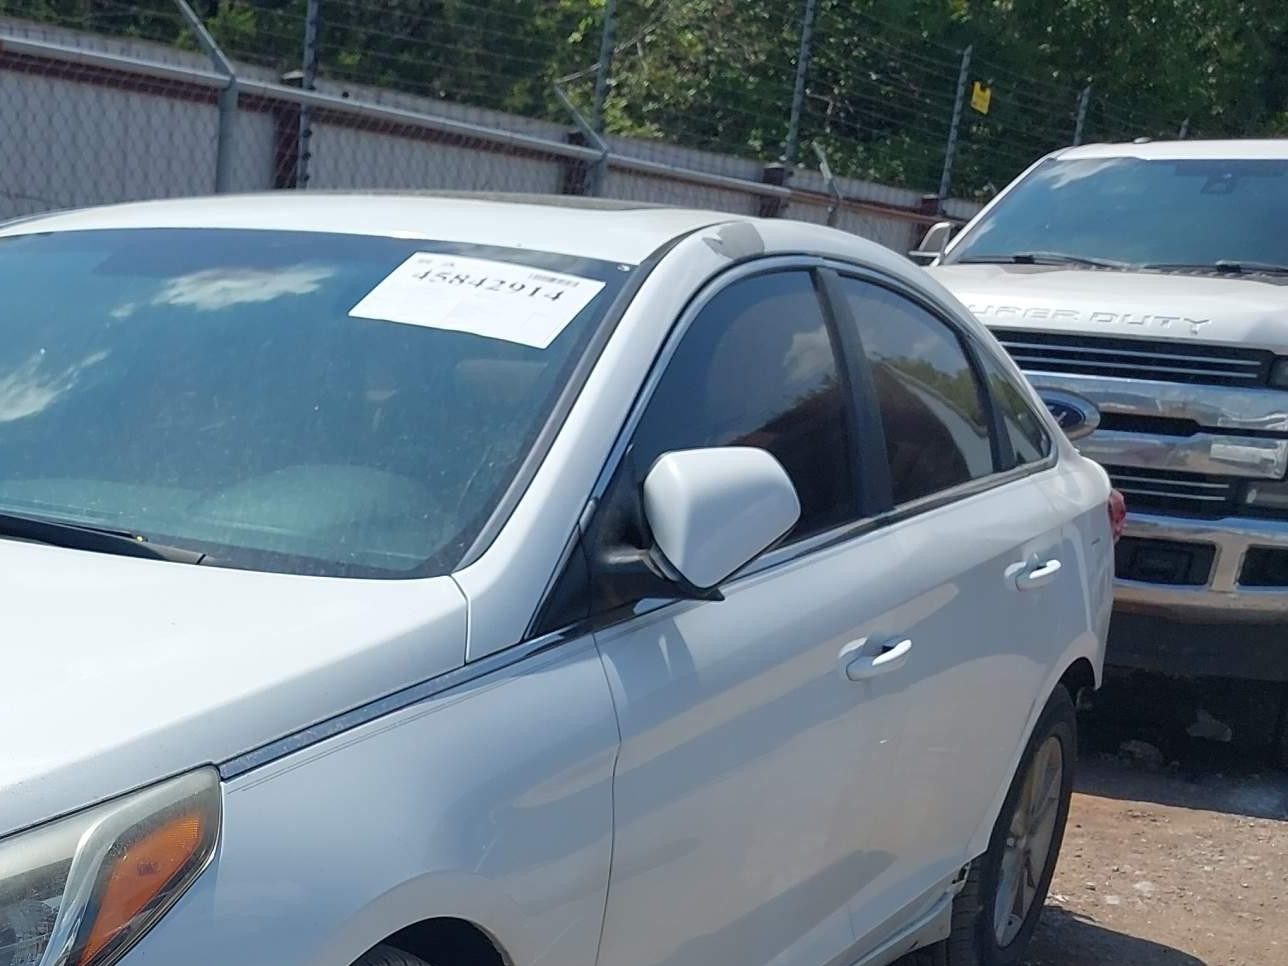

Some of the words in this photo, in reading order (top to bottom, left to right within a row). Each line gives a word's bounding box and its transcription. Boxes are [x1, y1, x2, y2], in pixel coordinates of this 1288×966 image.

[412, 269, 564, 301] 45842914
[967, 304, 1081, 321] UPER
[1089, 311, 1211, 335] DUTY
